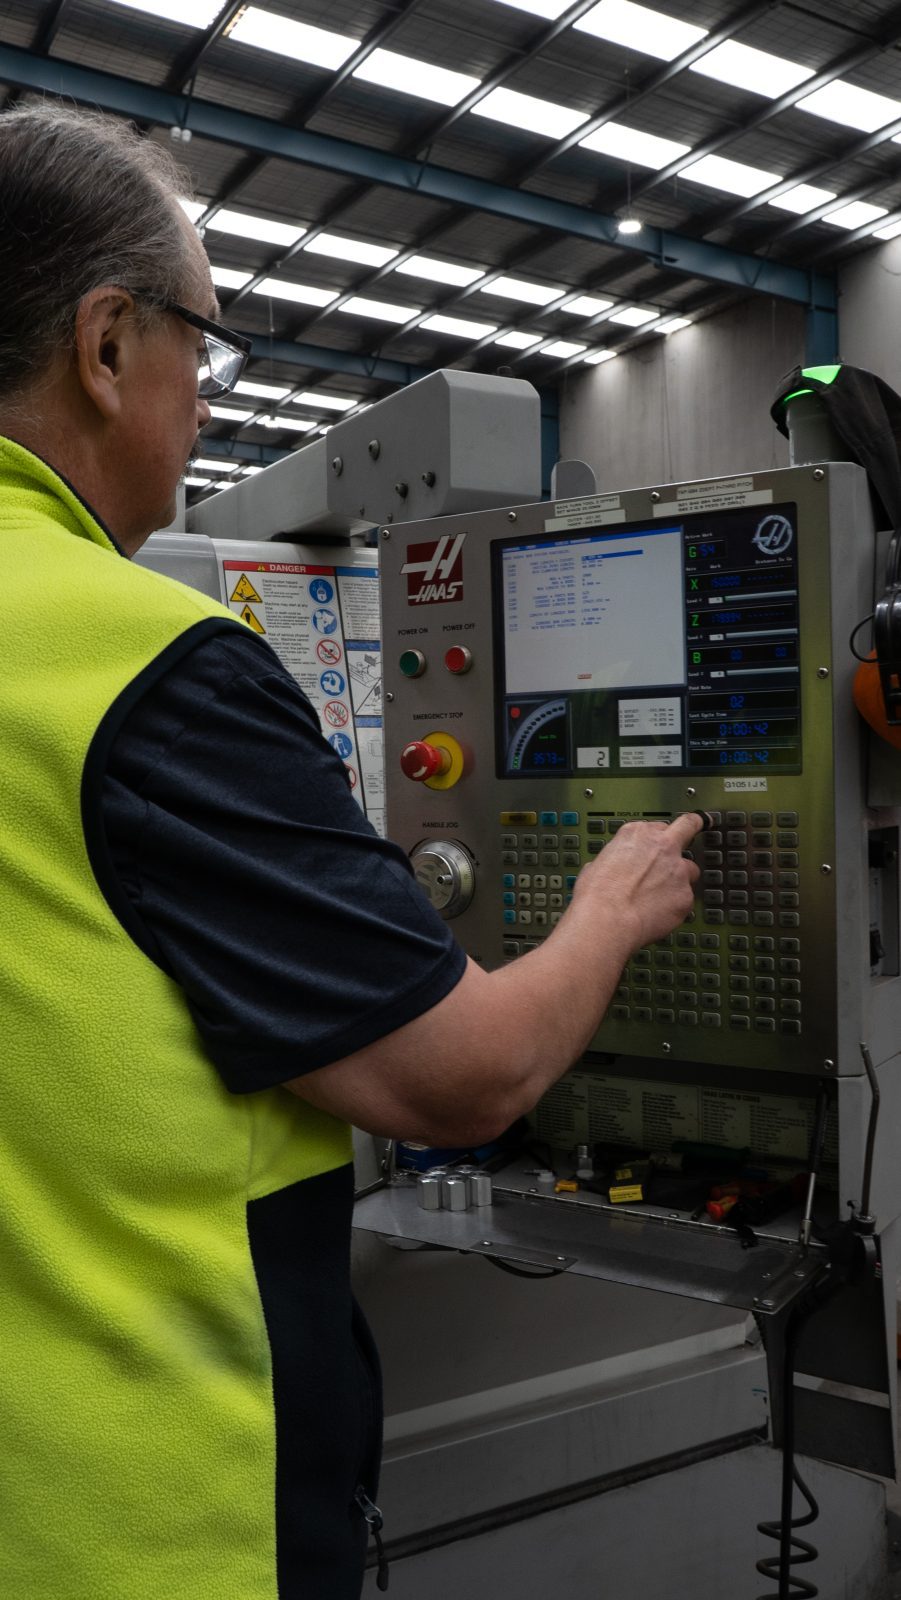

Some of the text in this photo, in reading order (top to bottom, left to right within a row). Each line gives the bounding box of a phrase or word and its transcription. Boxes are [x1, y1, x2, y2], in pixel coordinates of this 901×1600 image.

[689, 546, 697, 558] G
[269, 564, 306, 573] DANGER
[690, 579, 699, 590] X
[408, 581, 463, 602] HAAS
[691, 614, 699, 626] Z
[720, 722, 769, 736] 0:00:42
[597, 751, 605, 766] 2
[720, 751, 769, 764] 0:00:42
